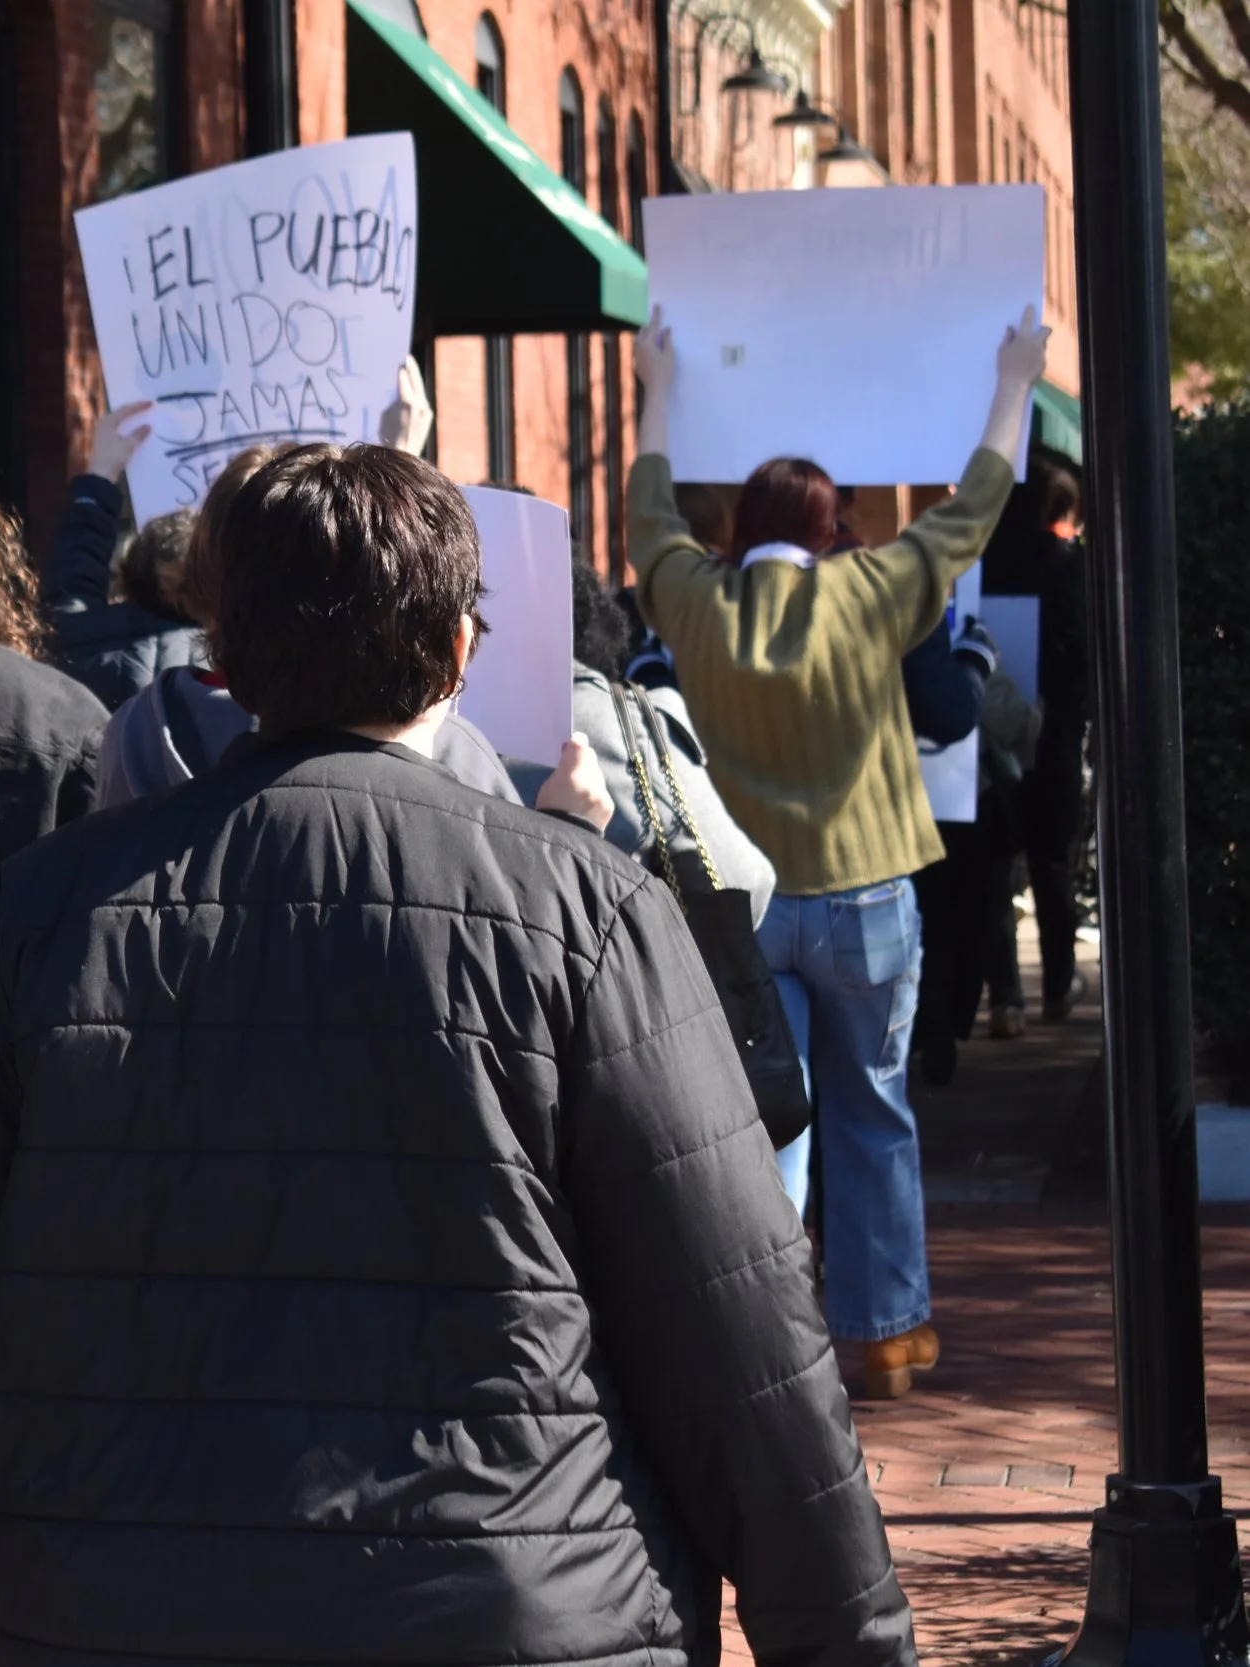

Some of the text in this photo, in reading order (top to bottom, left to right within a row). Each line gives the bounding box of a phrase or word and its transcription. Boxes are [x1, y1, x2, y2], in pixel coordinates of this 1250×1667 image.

[250, 208, 413, 312] PUEBLO
[132, 291, 337, 378] UNIDO
[155, 367, 349, 445] JAMAS
